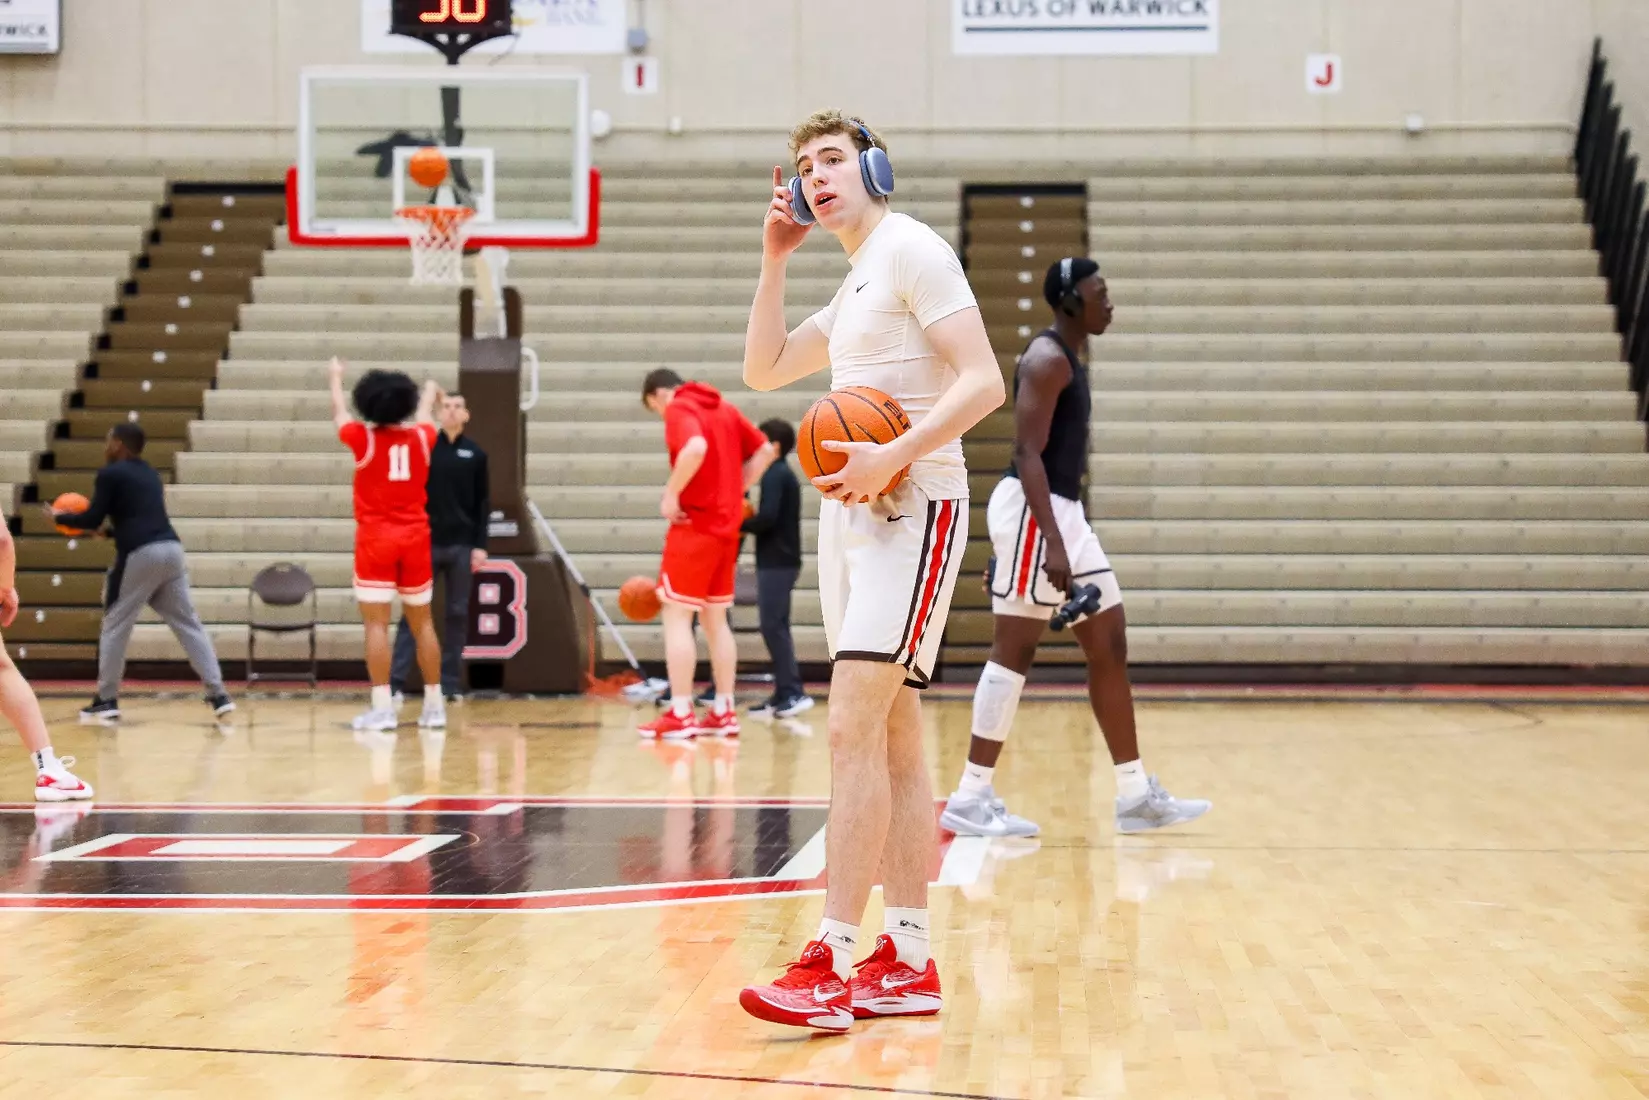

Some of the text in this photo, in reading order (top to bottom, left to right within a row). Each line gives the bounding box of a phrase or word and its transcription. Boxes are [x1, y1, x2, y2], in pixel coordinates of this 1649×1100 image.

[962, 0, 1209, 17] LEXUS OF WARWICK
[1313, 61, 1334, 87] J
[387, 443, 411, 481] 11
[461, 558, 528, 659] B
